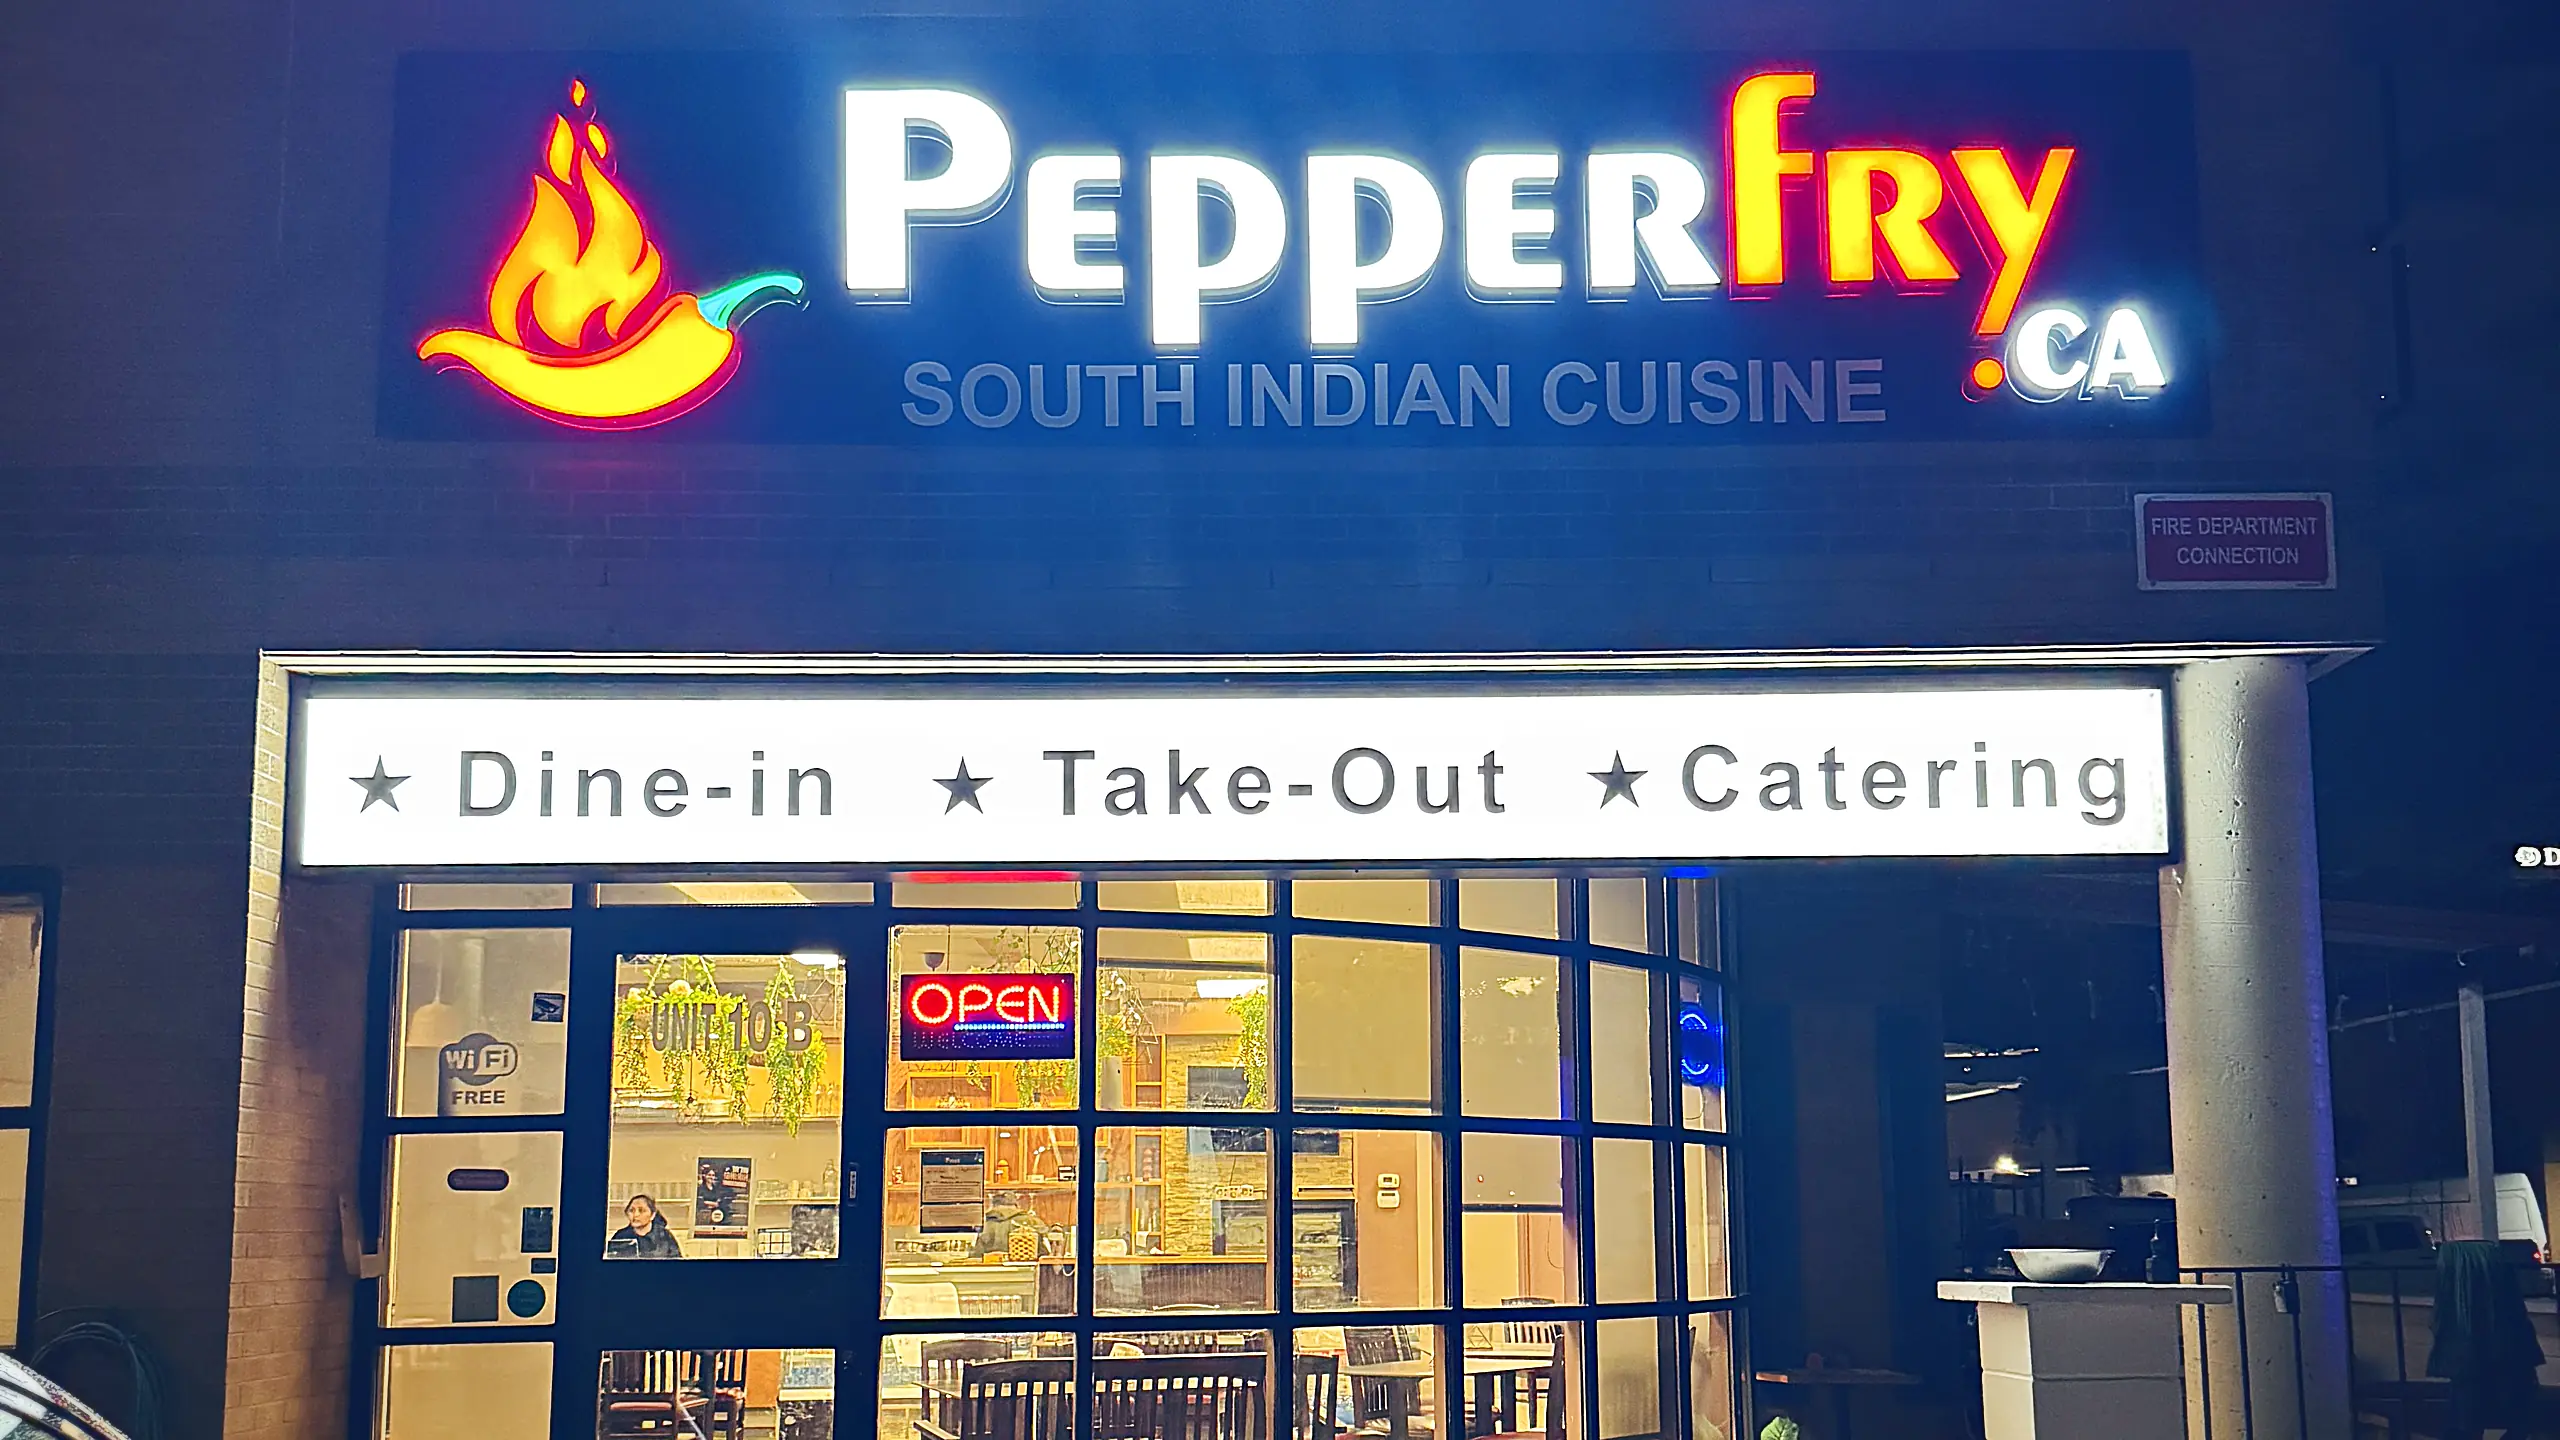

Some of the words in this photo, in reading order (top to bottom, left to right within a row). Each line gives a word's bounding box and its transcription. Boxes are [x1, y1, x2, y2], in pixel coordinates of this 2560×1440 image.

[902, 361, 1194, 428] SOUTH
[1227, 362, 1509, 428] INDIAN
[1542, 358, 1887, 426] CUISINE
[2151, 517, 2191, 535] FIRE
[2198, 517, 2318, 535] DEPARTMENT
[2177, 547, 2299, 564] CONNECTION
[459, 750, 833, 817] Dine-in
[1043, 747, 1505, 815] Take-Out
[1681, 741, 2126, 826] Catering
[911, 983, 1060, 1024] OPEN
[652, 1002, 716, 1051] UNIT
[729, 1001, 772, 1051] 10
[786, 1001, 813, 1051] B
[451, 1090, 506, 1105] FREE
